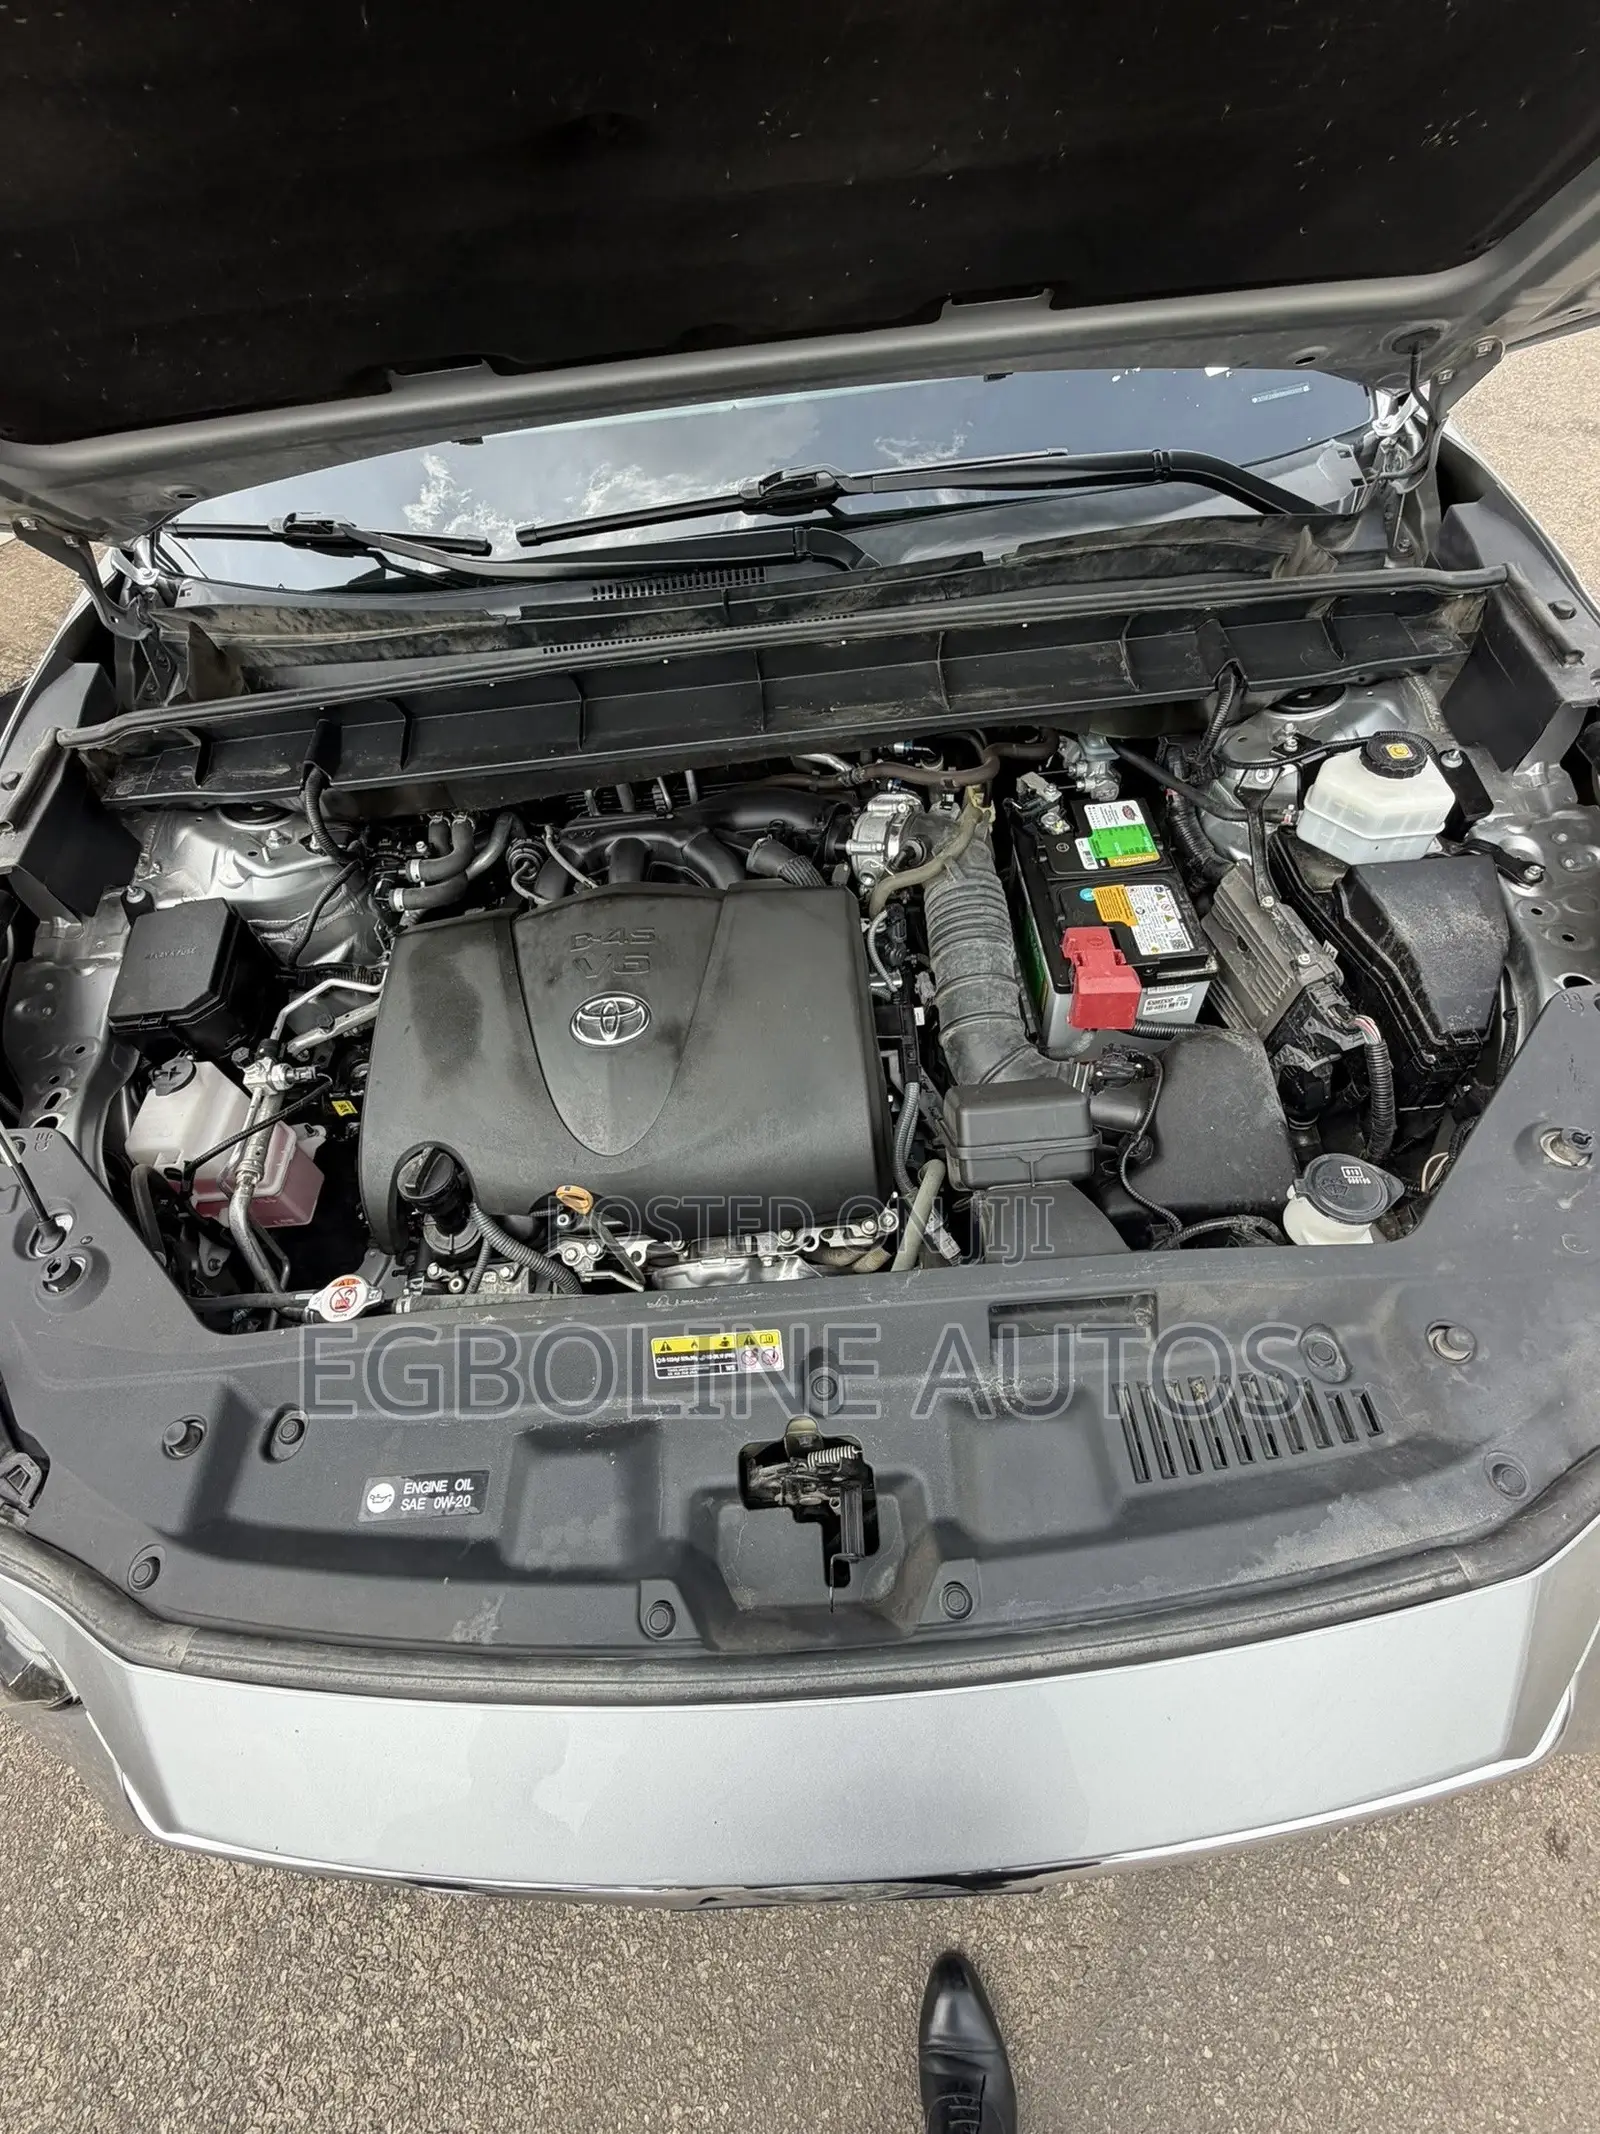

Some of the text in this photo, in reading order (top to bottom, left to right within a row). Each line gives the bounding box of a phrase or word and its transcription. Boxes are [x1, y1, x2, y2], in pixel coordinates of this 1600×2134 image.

[572, 953, 651, 979] V6
[403, 1478, 475, 1495] ENGINE OIL
[400, 1494, 471, 1511] SAE 0W-20
